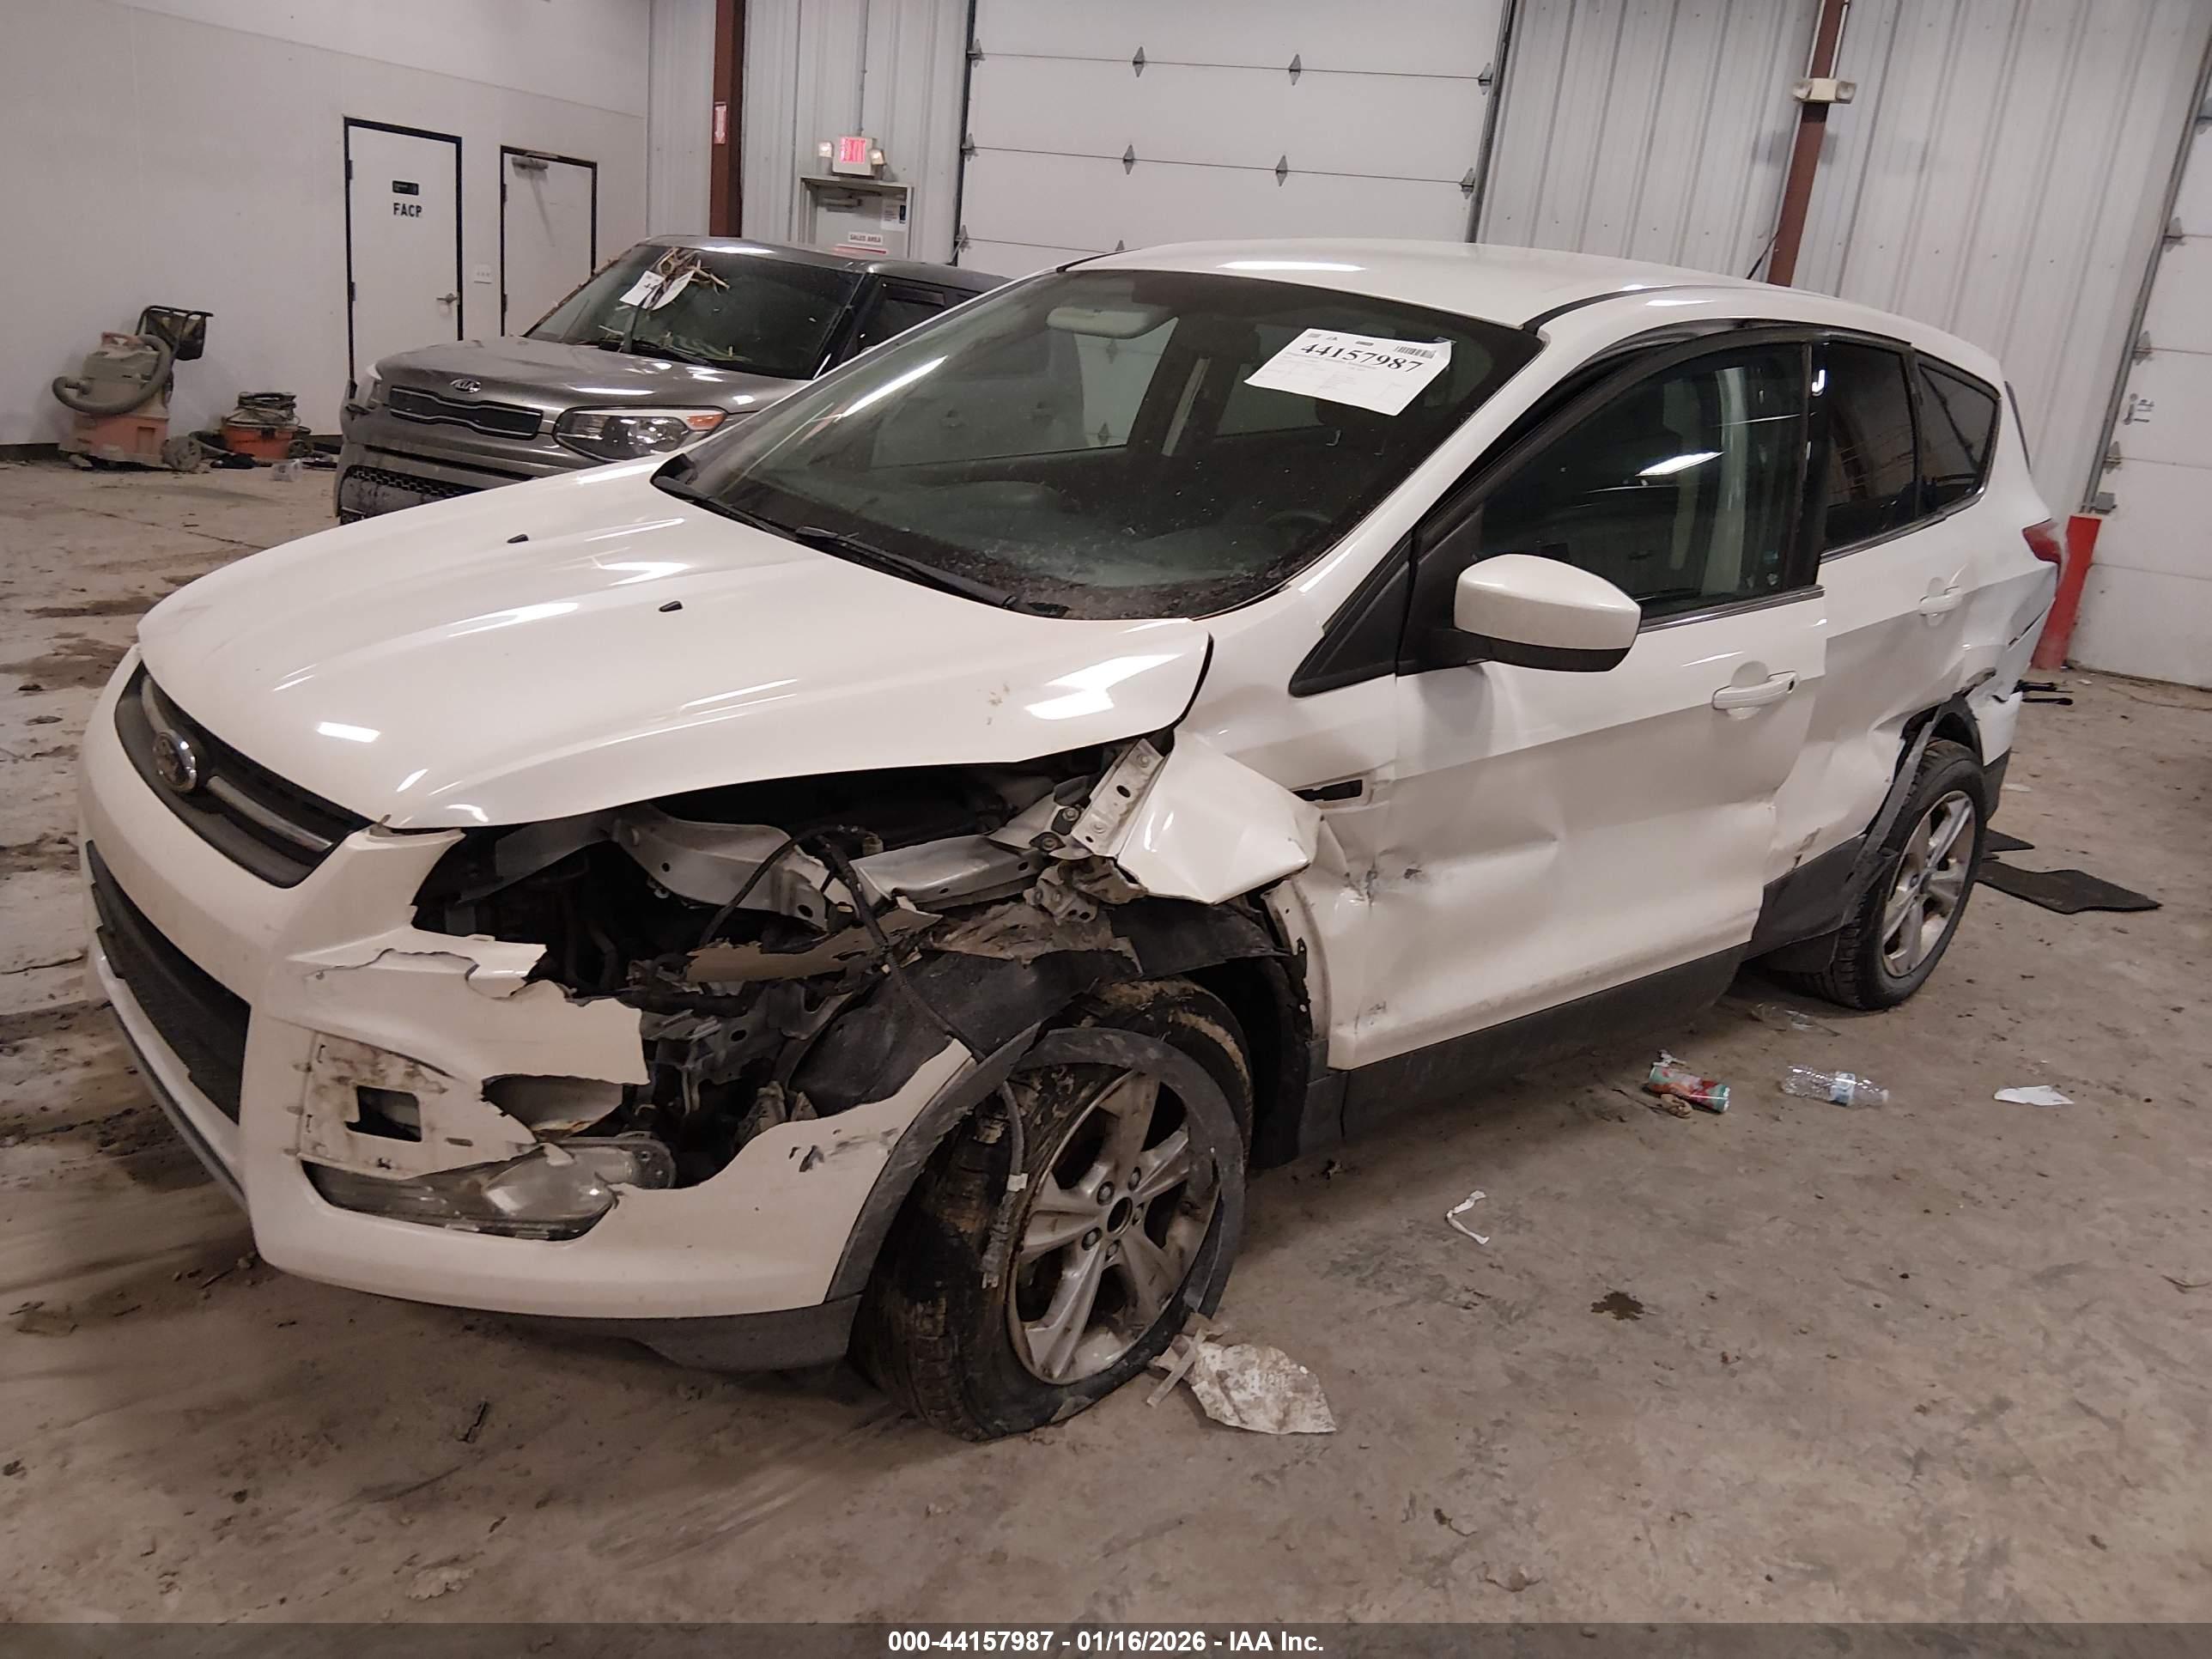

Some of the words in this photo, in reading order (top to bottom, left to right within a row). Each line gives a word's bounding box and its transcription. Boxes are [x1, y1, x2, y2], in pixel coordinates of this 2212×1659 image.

[840, 137, 866, 162] EXIT
[392, 202, 422, 217] FACP
[1300, 343, 1425, 373] 44157987
